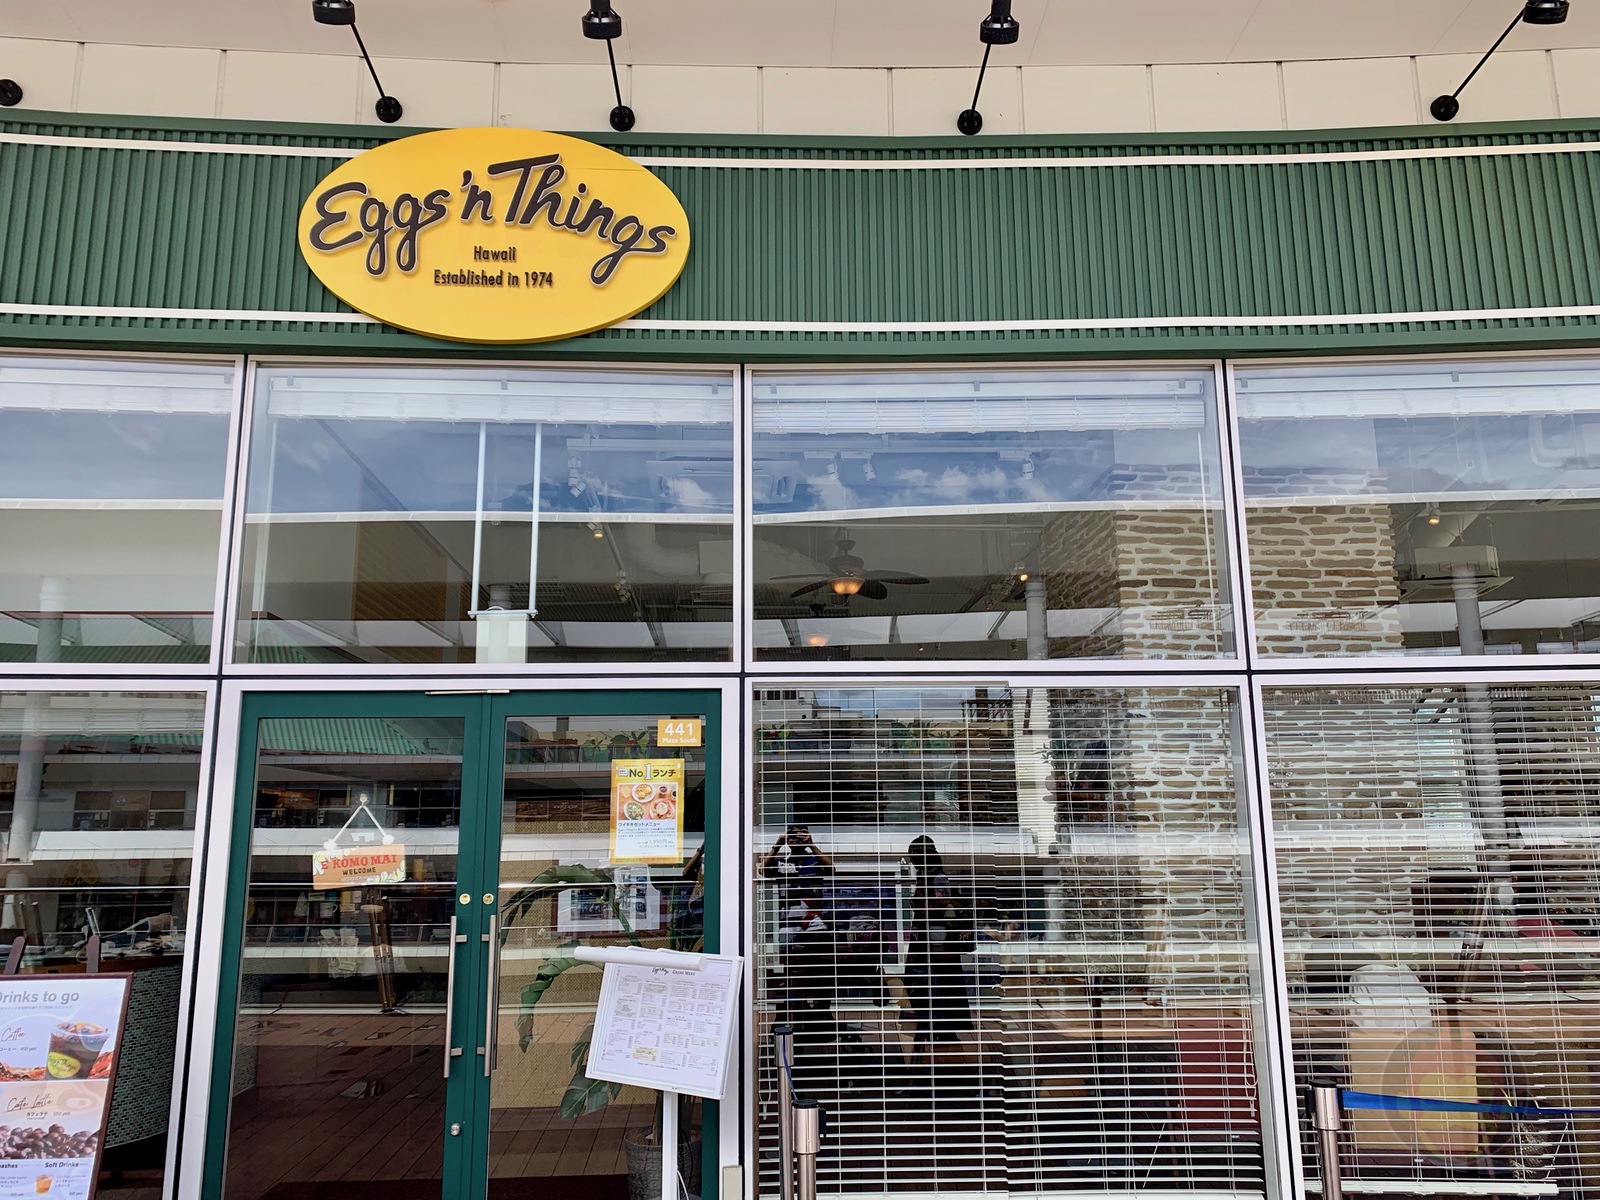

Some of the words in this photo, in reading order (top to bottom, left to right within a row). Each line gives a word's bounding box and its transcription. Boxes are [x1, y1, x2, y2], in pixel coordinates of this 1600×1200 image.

[309, 180, 451, 278] Eggs
[460, 169, 496, 224] 'n
[487, 153, 677, 287] Things
[473, 245, 517, 262] Hawaii
[434, 269, 504, 286] Established
[507, 272, 520, 286] in
[524, 271, 553, 287] 1974
[664, 722, 694, 736] 441
[321, 860, 329, 870] E
[333, 856, 369, 869] KOMO
[370, 854, 397, 865] MAI
[342, 866, 376, 876] WELCOME
[0, 990, 39, 1004] rinks
[42, 991, 57, 1003] to
[60, 992, 80, 1005] go
